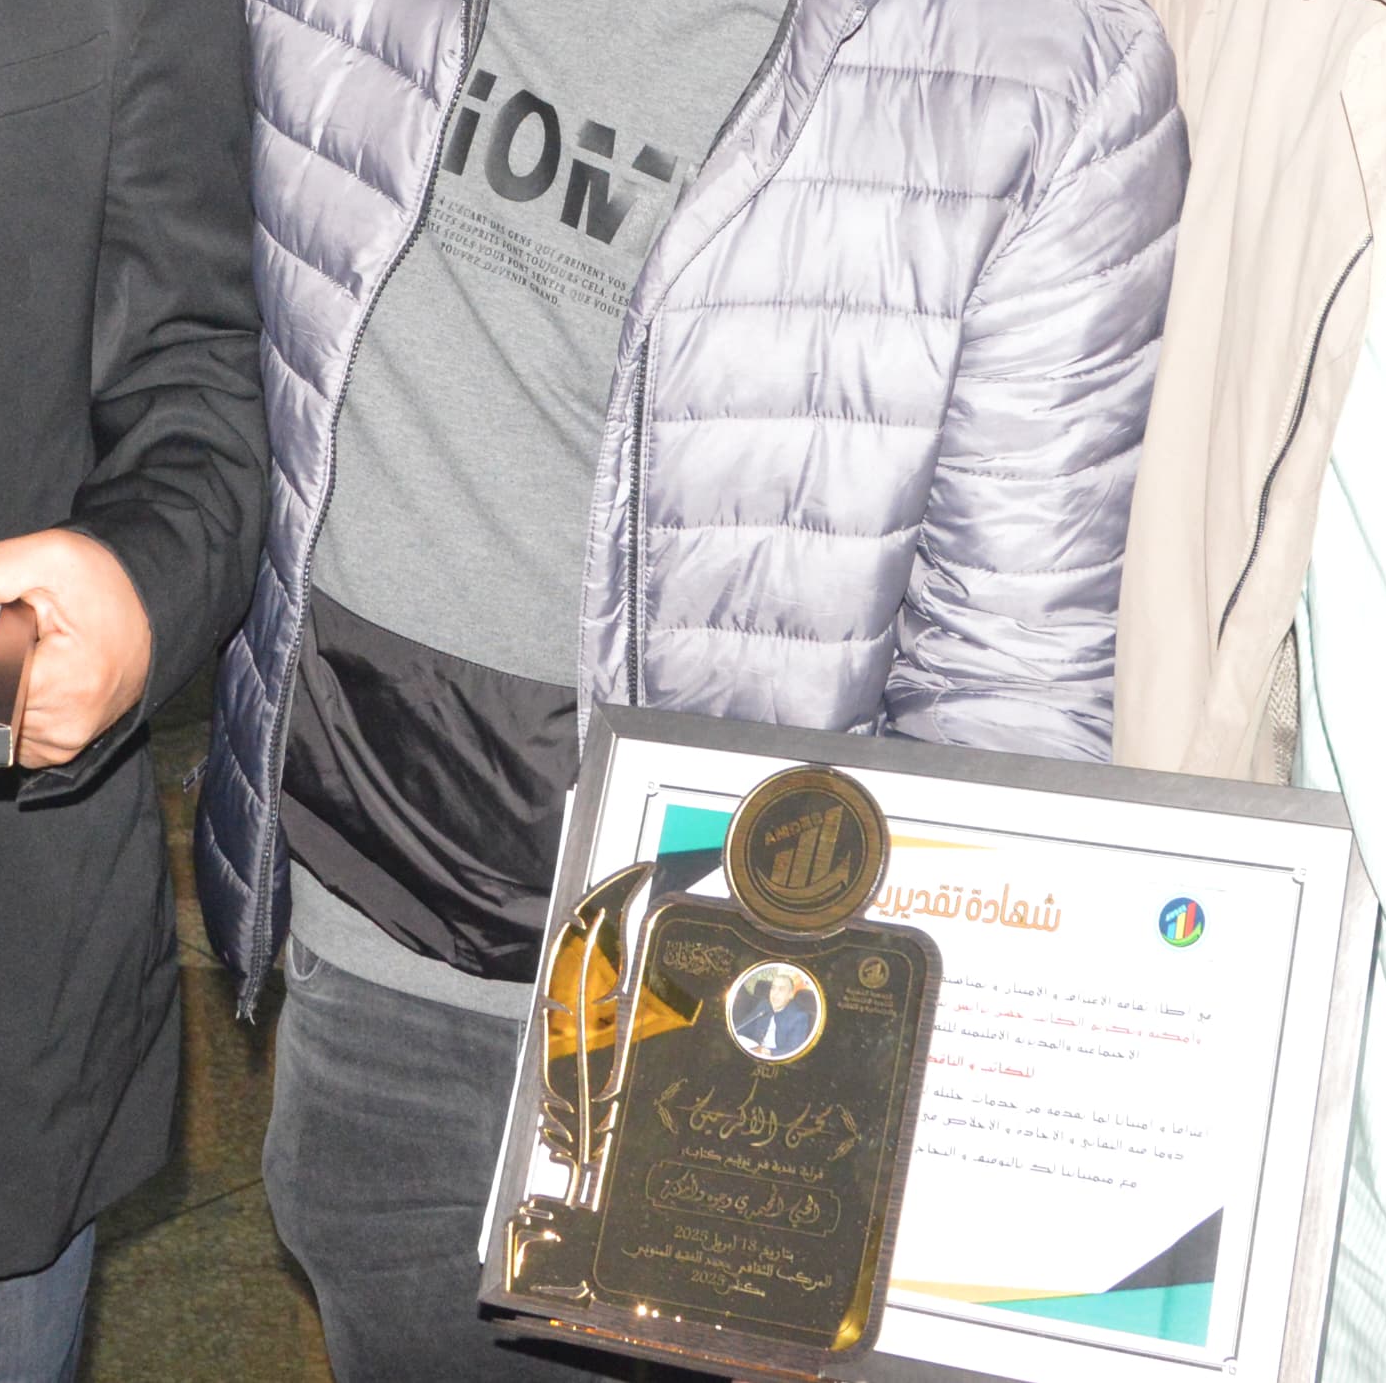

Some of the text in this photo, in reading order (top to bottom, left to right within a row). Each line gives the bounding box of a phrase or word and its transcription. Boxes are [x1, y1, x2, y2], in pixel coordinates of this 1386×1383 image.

[506, 229, 532, 247] GENS
[533, 242, 556, 259] QUI
[606, 275, 628, 291] VOS
[477, 243, 505, 262] VOUS
[592, 298, 621, 318] VOUS
[871, 883, 1061, 932] شهادة تقديري
[673, 1225, 709, 1242] 2025
[741, 1238, 758, 1251] 18
[690, 1270, 726, 1286] 2025
